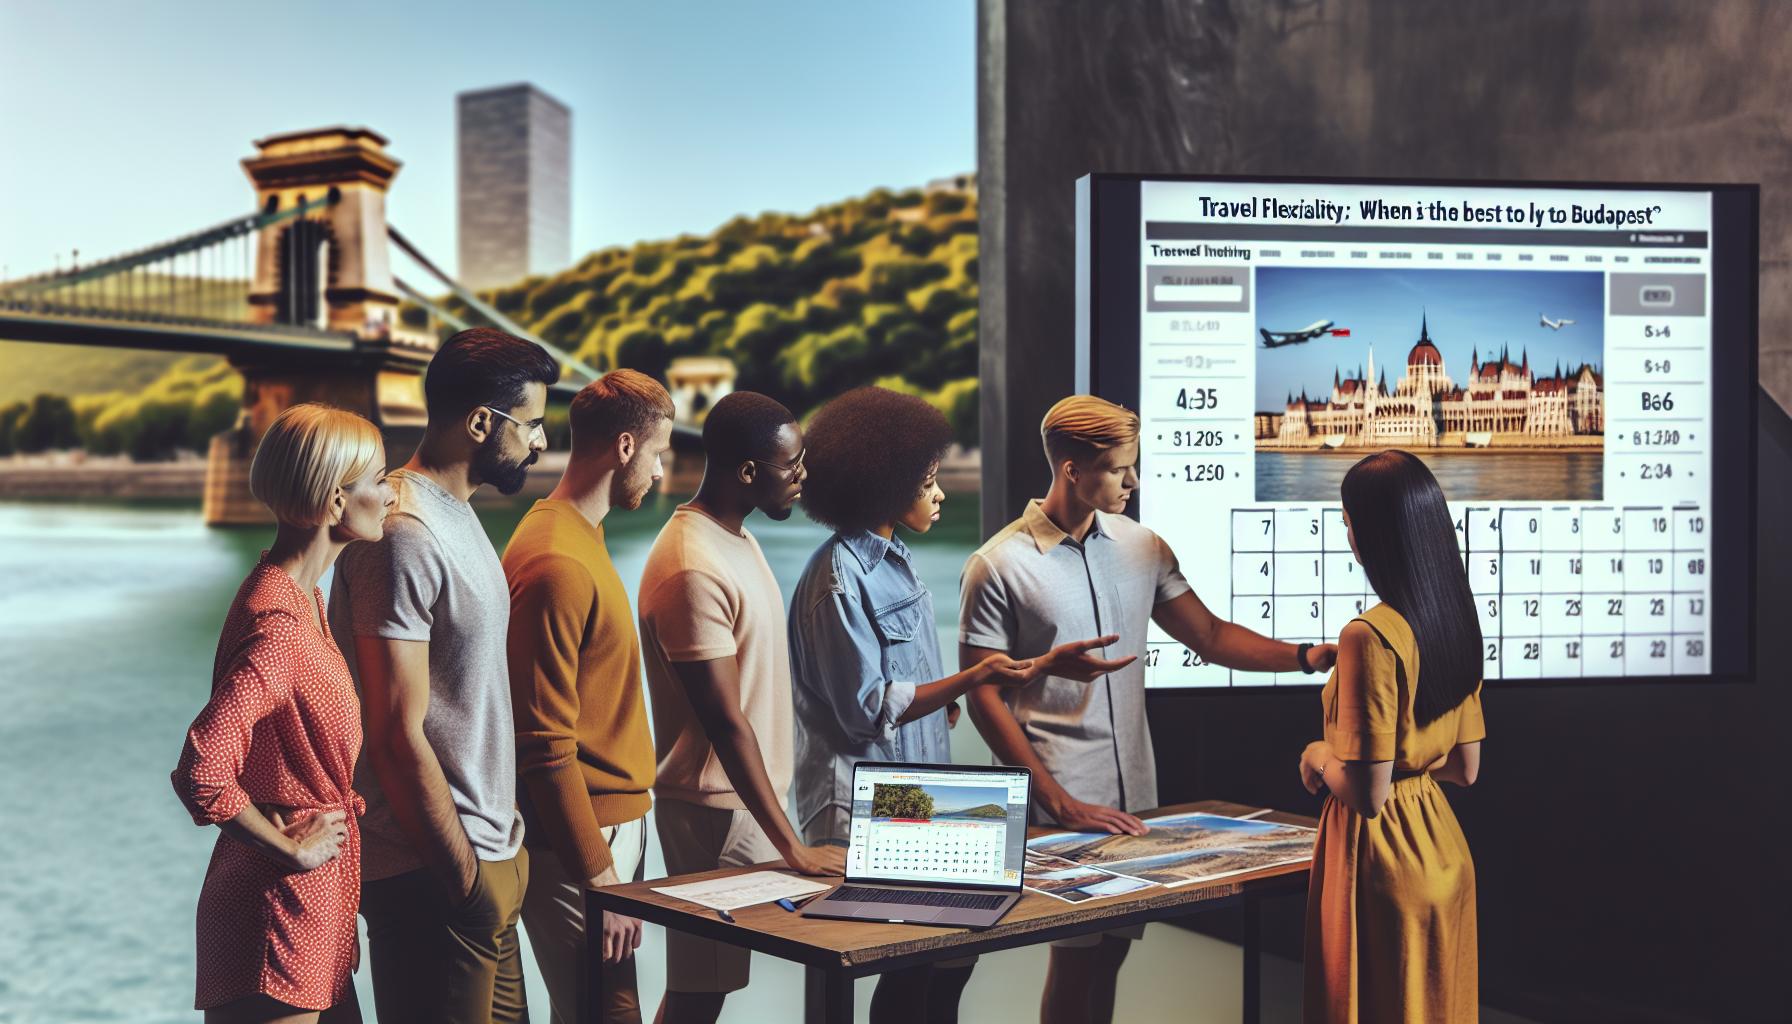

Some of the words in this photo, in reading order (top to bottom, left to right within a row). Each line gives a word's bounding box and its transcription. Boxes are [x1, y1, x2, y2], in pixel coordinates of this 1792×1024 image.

[1199, 197, 1257, 217] Travel
[1360, 199, 1412, 220] When
[1463, 201, 1503, 223] best
[1506, 206, 1525, 223] to
[1548, 207, 1567, 223] to
[1261, 519, 1271, 535] 7
[1529, 518, 1538, 534] 0
[1261, 601, 1271, 619] 2
[1523, 600, 1539, 617] 12
[1485, 644, 1498, 661] 2
